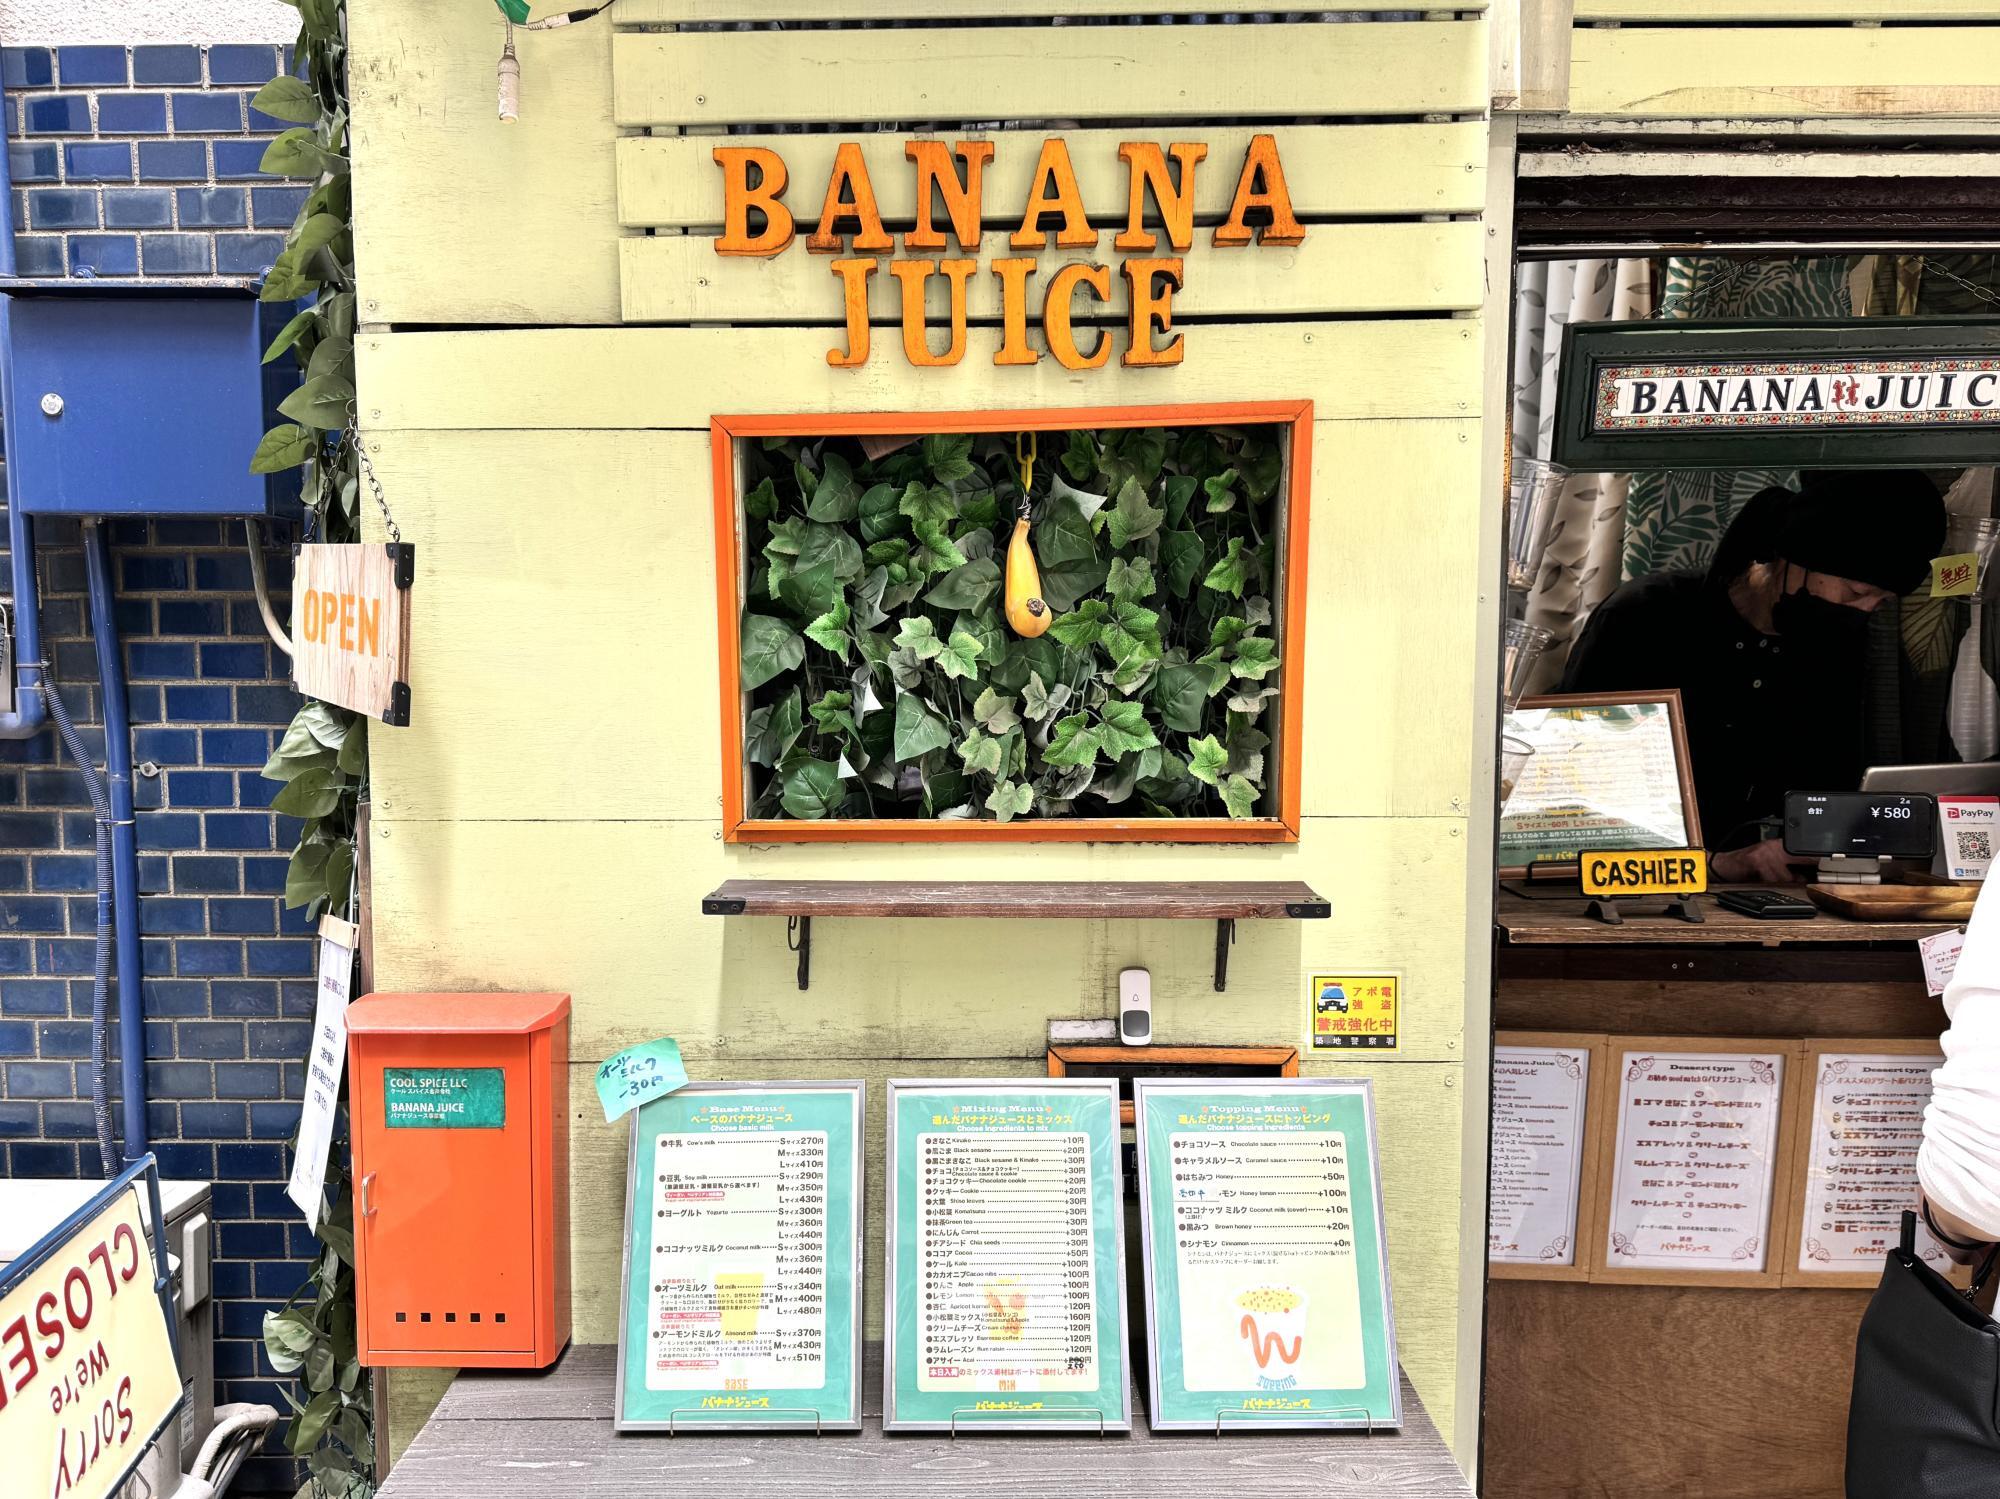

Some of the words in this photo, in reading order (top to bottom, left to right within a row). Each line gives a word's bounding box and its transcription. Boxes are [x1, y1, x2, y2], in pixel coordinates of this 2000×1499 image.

[713, 134, 1305, 256] BANANA
[827, 258, 1184, 369] JUICE
[1630, 376, 1824, 415] BANANA
[1865, 373, 2000, 411] JUIC
[303, 588, 381, 657] OPEN
[1884, 808, 1910, 818] 580
[1961, 809, 1994, 818] PayPay
[1591, 856, 1697, 887] CASHIER
[1317, 1018, 1392, 1031] 警戒強化中
[390, 1079, 417, 1087] COOL
[420, 1079, 447, 1087] SPICE
[450, 1079, 468, 1088] LLC
[391, 1103, 434, 1112] BANANA
[436, 1103, 464, 1112] JUICE
[691, 1114, 793, 1123] ベースのバナナジュース
[1182, 1157, 1242, 1165] キャラメルソース
[1321, 1156, 1343, 1165] +10円
[779, 1172, 823, 1180] Sサイズ290円
[1322, 1173, 1345, 1181] +50円
[1317, 1189, 1346, 1197] +100円
[665, 1209, 702, 1218] ヨーグルト
[778, 1208, 823, 1216] Sサイズ300円
[1325, 1206, 1348, 1214] +10円
[1326, 1223, 1349, 1231] +20円
[664, 1245, 723, 1253] ココナッツミルク
[776, 1255, 823, 1263] Mサイズ360円
[778, 1267, 822, 1276] Lサイズ440円
[775, 1295, 822, 1303] Mサイズ400円
[0, 1222, 139, 1412] CLOSE
[660, 1330, 721, 1338] アーモンドミルク
[776, 1354, 821, 1362] Lサイズ510円
[55, 1375, 133, 1499] Sorry
